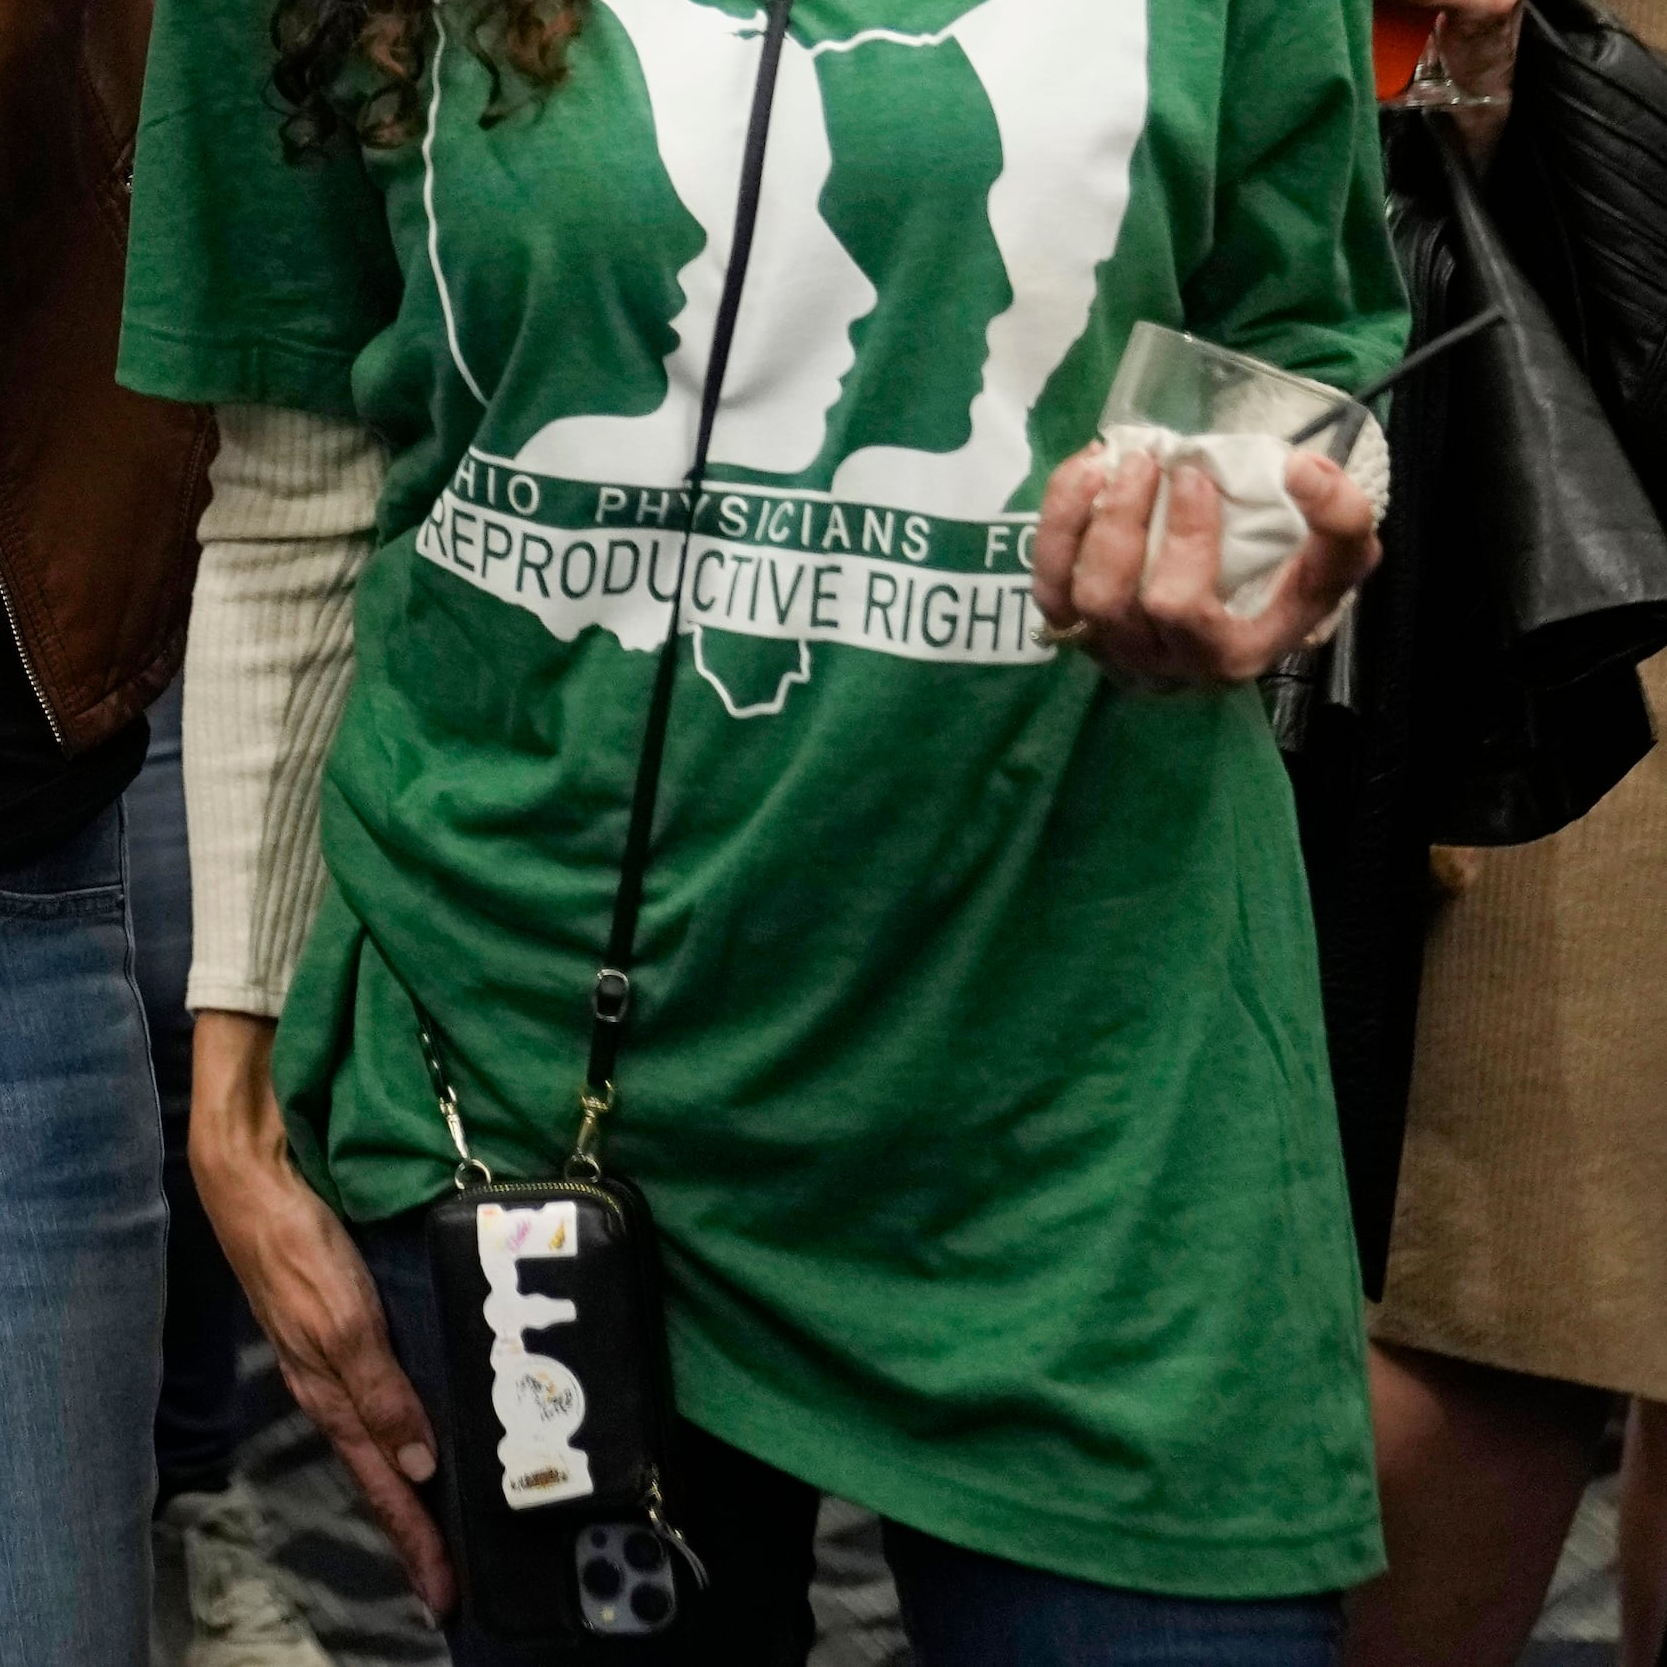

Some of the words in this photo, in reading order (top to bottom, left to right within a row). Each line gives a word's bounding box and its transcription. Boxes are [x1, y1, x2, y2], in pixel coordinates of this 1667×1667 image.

[423, 497, 839, 629] REPRODUCTIVE
[864, 570, 1034, 651] RIGHT
[453, 458, 540, 516] HIO
[595, 485, 931, 563] PHYSICIANS
